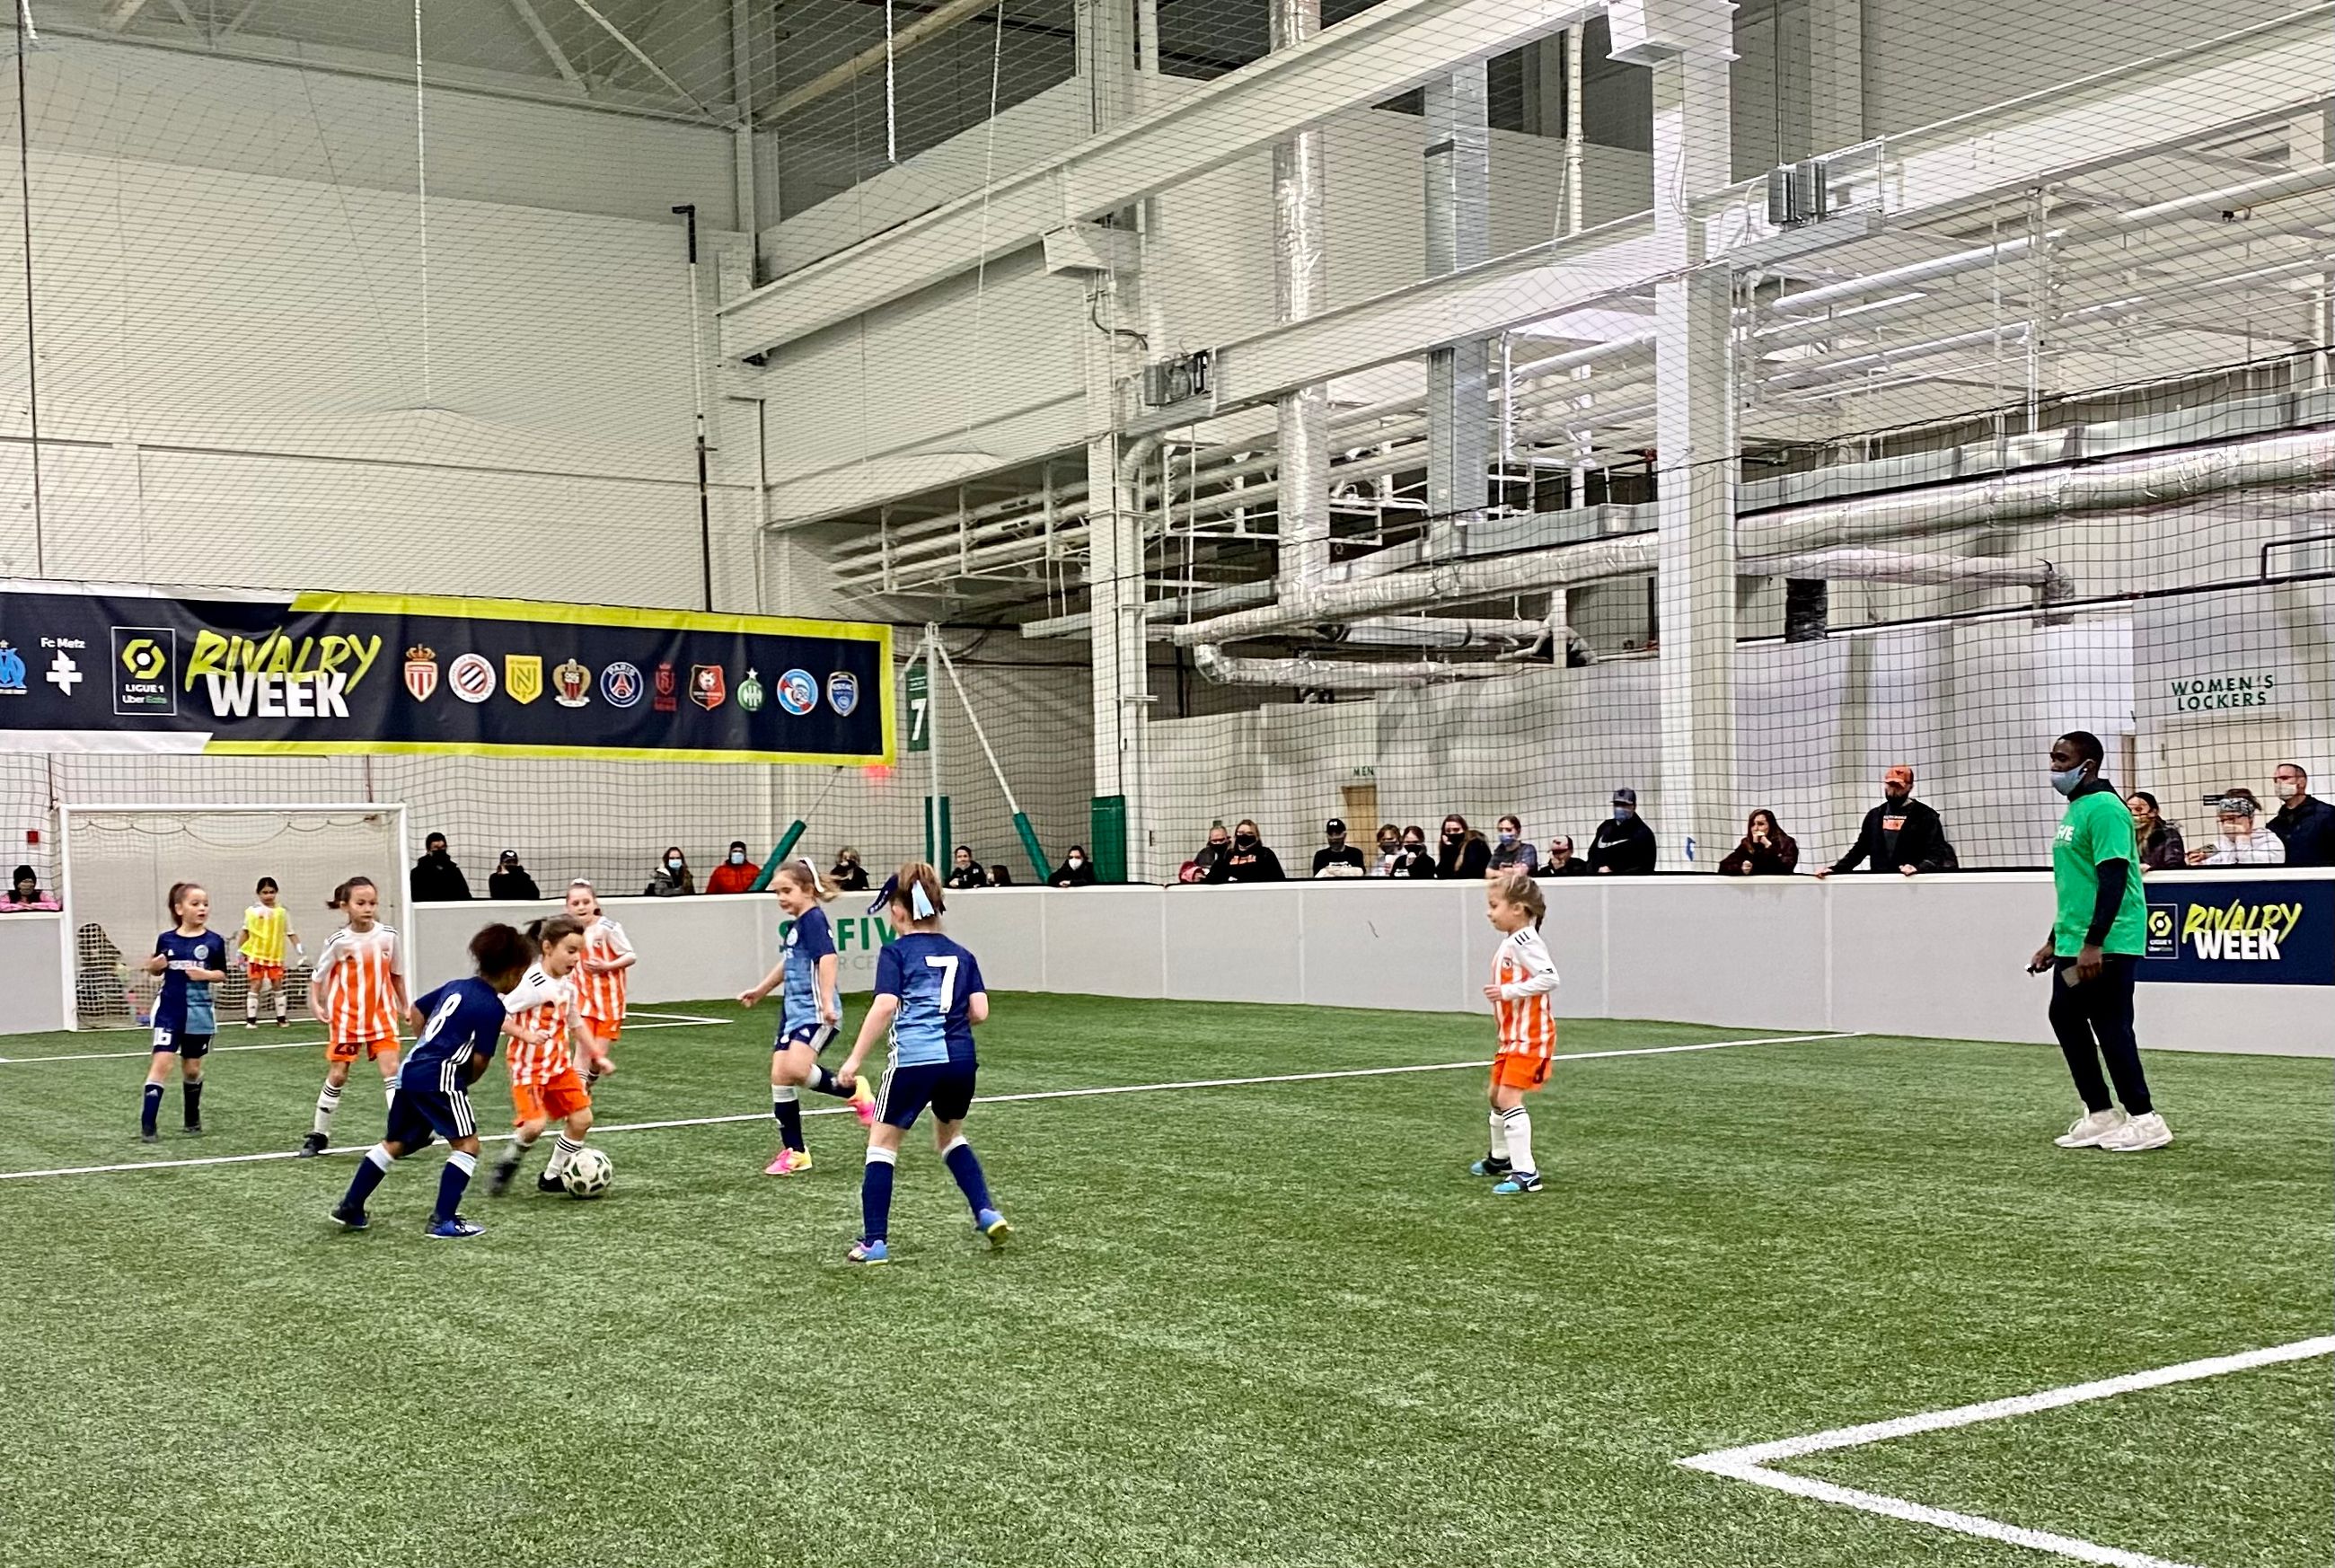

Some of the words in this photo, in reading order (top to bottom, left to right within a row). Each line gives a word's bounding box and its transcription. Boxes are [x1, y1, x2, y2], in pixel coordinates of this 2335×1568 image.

[40, 638, 56, 647] Fc
[57, 638, 86, 648] Metz
[184, 626, 382, 694] RIVALRY
[125, 684, 157, 692] LIGUE
[158, 685, 164, 693] 1
[206, 672, 349, 717] WEEK
[2172, 675, 2274, 695] WOMEN'S
[2178, 692, 2267, 710] LOCKERS
[911, 698, 928, 741] 7
[2181, 899, 2303, 944] RIVALRY
[2194, 929, 2281, 960] WEEK
[924, 955, 959, 1014] 7
[425, 992, 463, 1042] 8
